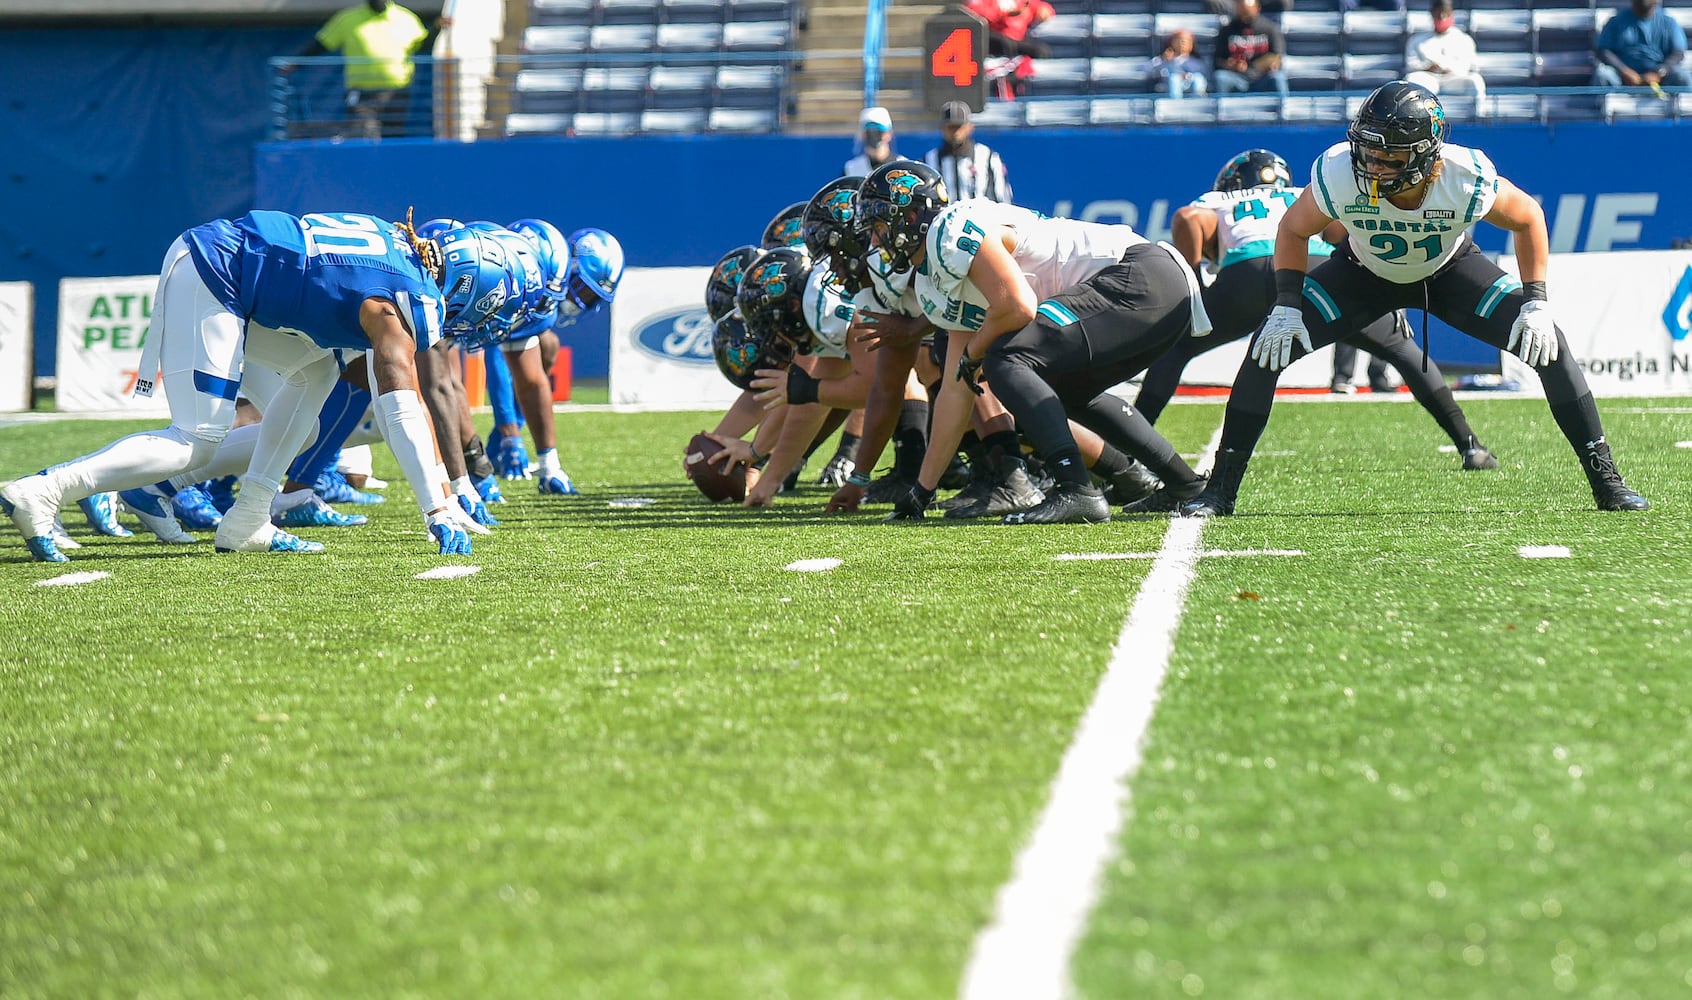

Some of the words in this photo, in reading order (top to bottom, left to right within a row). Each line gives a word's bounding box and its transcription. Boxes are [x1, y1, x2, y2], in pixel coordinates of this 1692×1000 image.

[932, 28, 978, 87] 4
[1352, 219, 1452, 232] COASTAL
[1425, 210, 1453, 218] EQUALITY
[299, 213, 388, 257] 20
[956, 219, 985, 256] 87
[1369, 233, 1443, 264] 21
